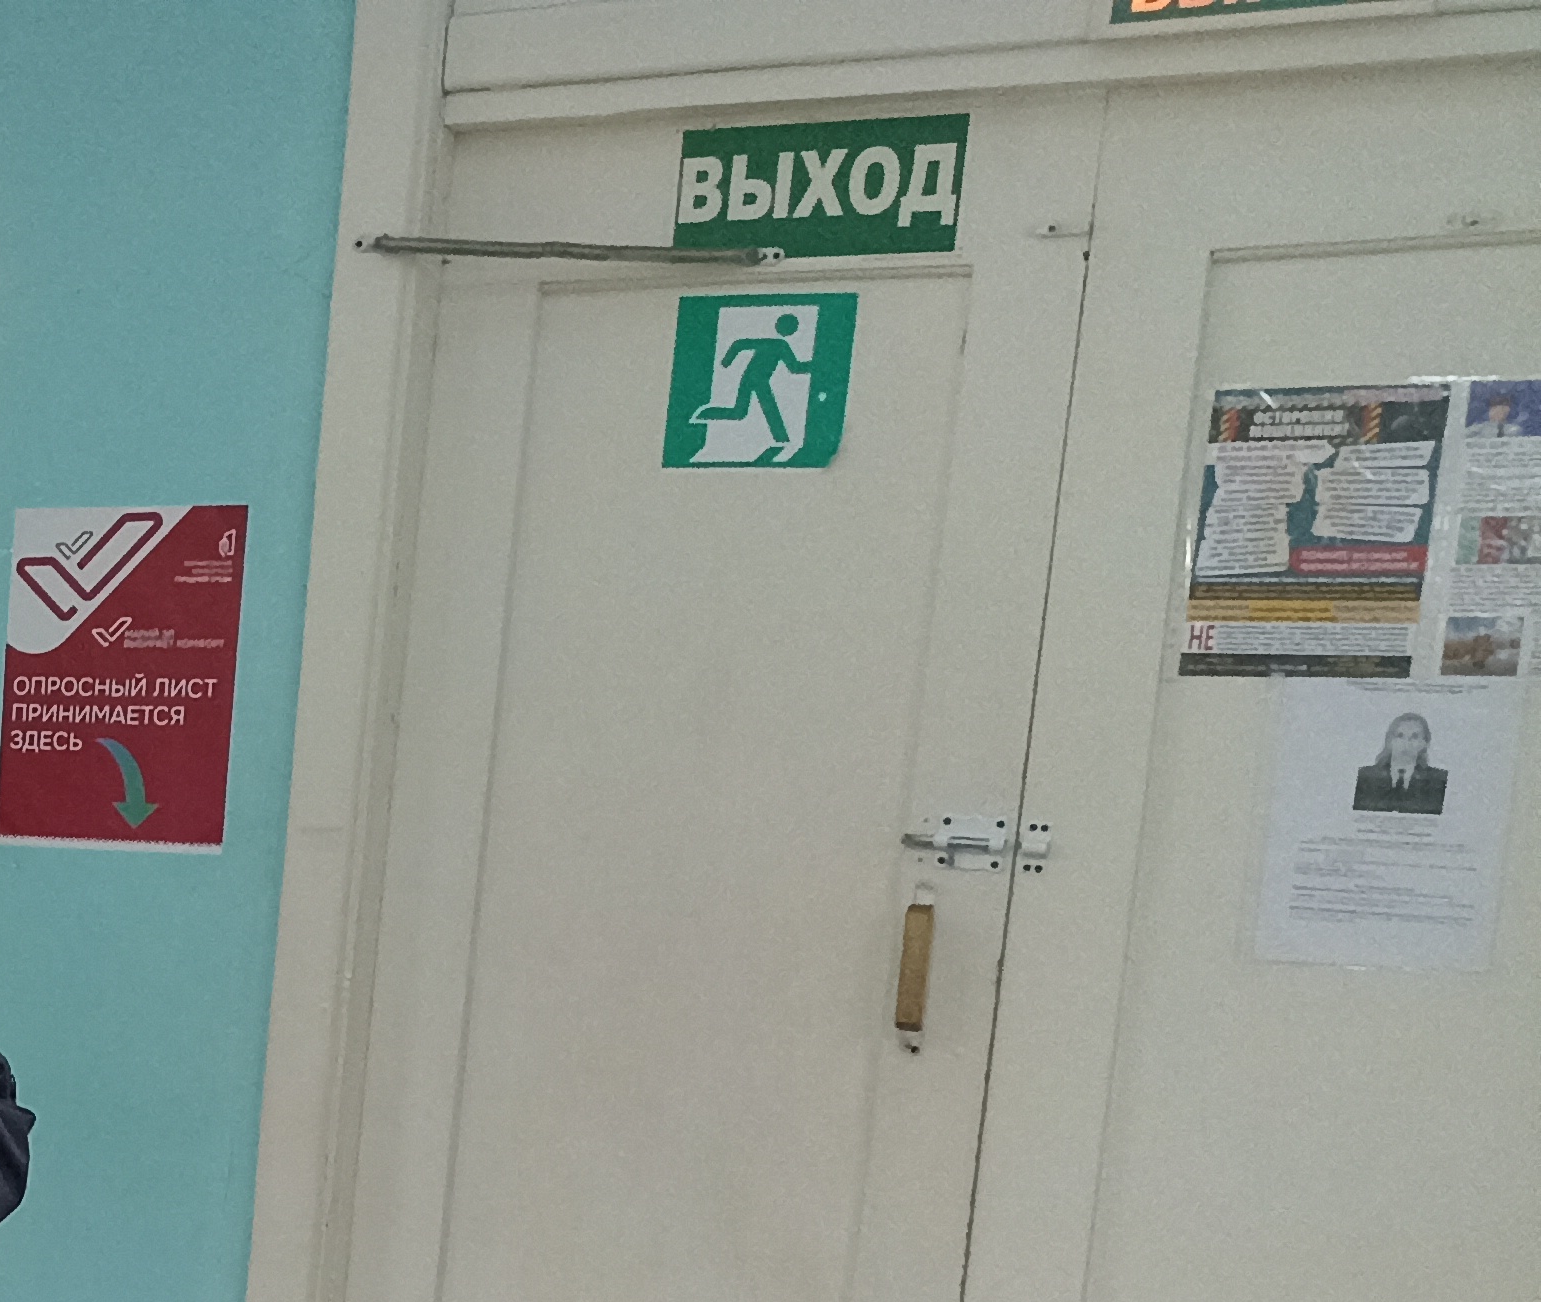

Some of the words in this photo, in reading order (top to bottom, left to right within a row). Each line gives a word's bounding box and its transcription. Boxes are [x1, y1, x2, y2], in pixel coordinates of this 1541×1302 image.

[677, 142, 958, 228] ВЫХОД
[1187, 624, 1216, 651] НЕ
[13, 673, 147, 698] ОПРОСНЫЙ
[153, 678, 219, 699] ЛИСТ
[11, 703, 185, 726] ПРИНИМАЕТСЯ
[10, 730, 84, 754] ЗДЕСЬ
